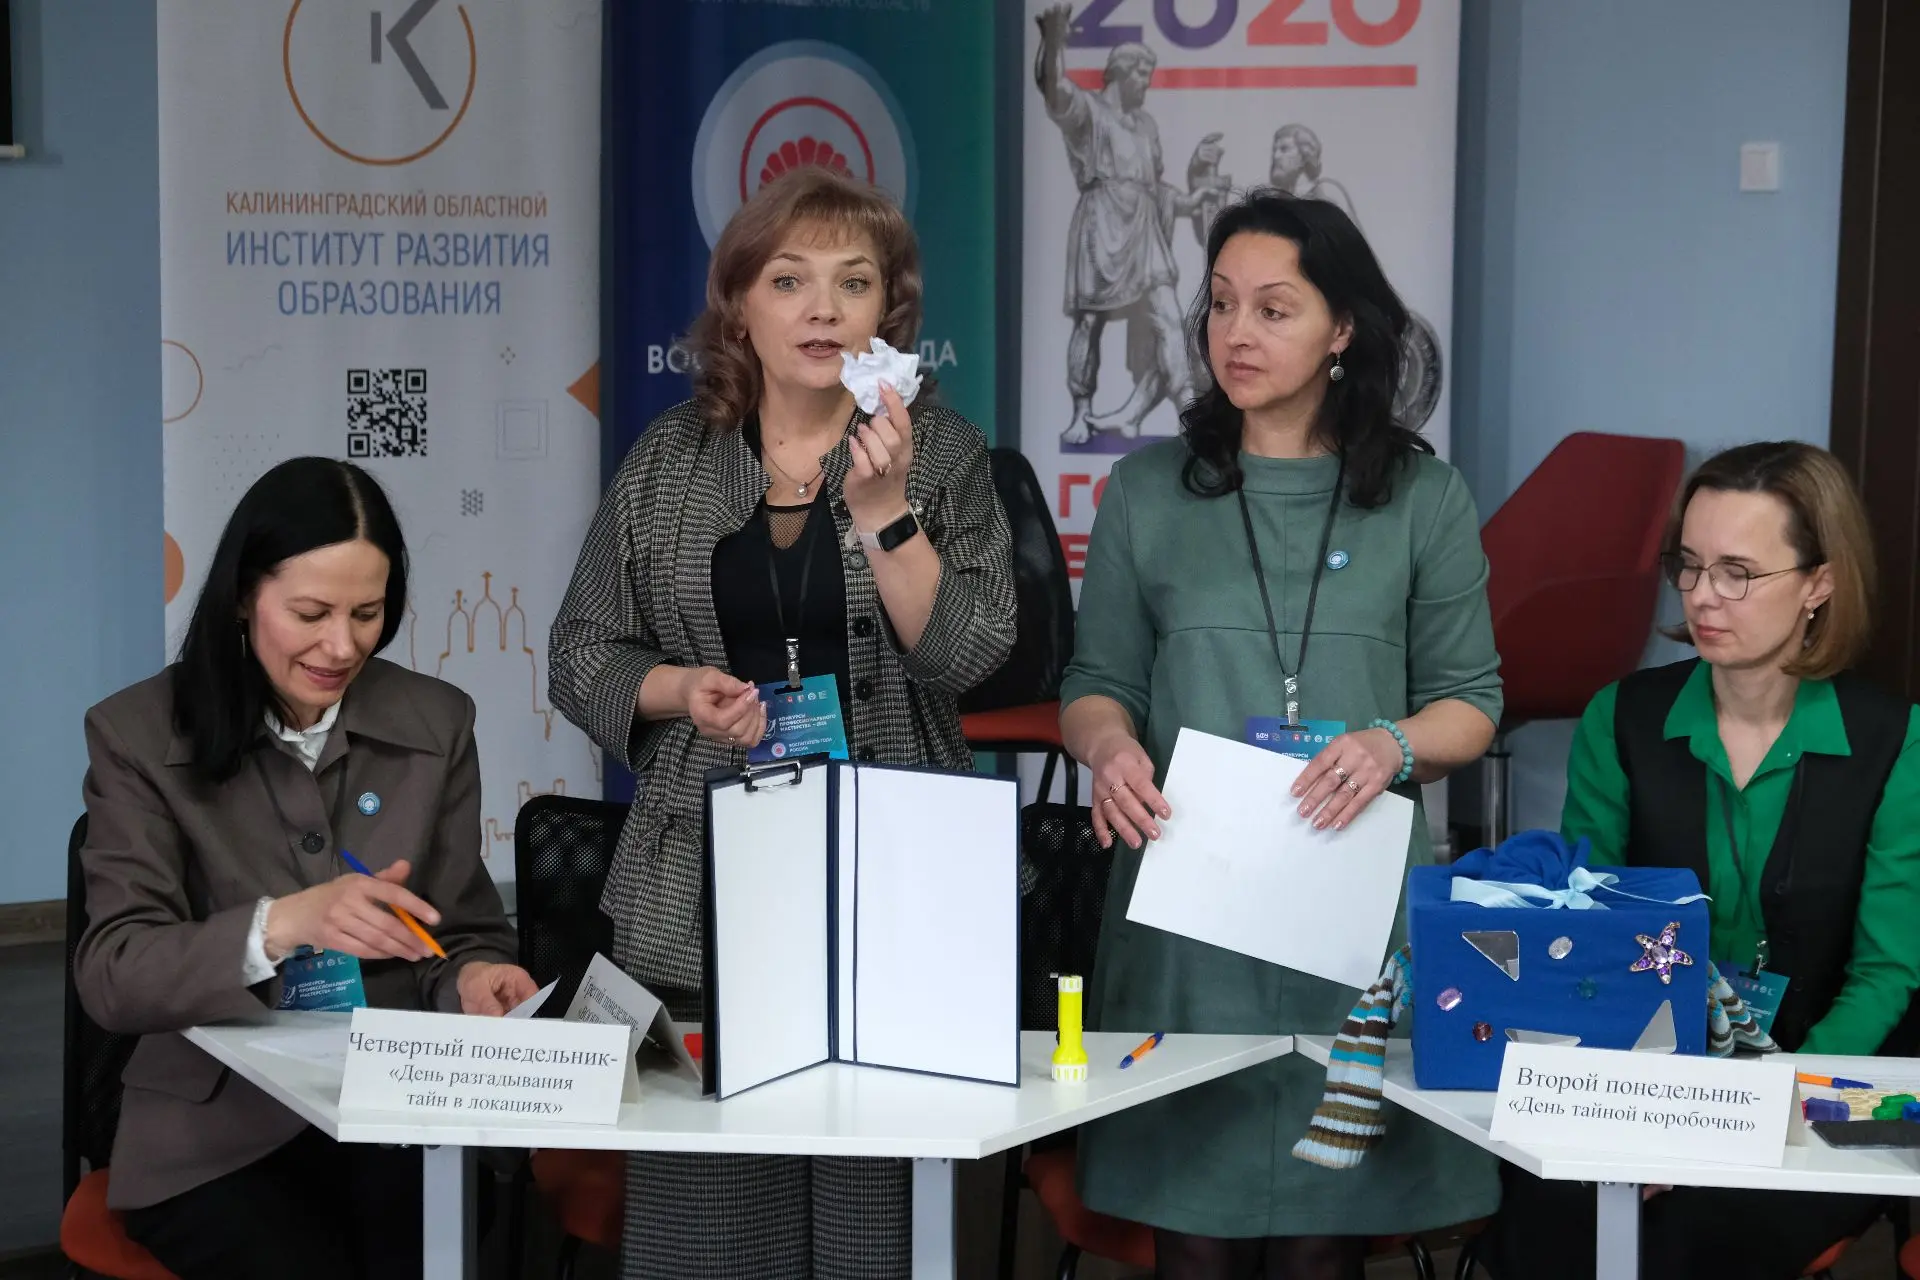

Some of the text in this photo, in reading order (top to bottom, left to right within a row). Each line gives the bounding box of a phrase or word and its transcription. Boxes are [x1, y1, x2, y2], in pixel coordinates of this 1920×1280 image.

[226, 190, 547, 219] КАЛИНИНГРАДСКИЙ ОБЛАСТНОЙ
[226, 231, 549, 268] ИНСТИТУТ РАЗВИТИЯ
[278, 280, 501, 316] ОБРАЗОВАНИЯ
[349, 1032, 618, 1067] Четвертый понедельник-
[389, 1064, 573, 1091] «День разгадывания
[1516, 1067, 1761, 1106] Второй понедельник-
[406, 1091, 563, 1115] тайн в локациях»
[1508, 1096, 1756, 1132] «День тайной коробочки»
